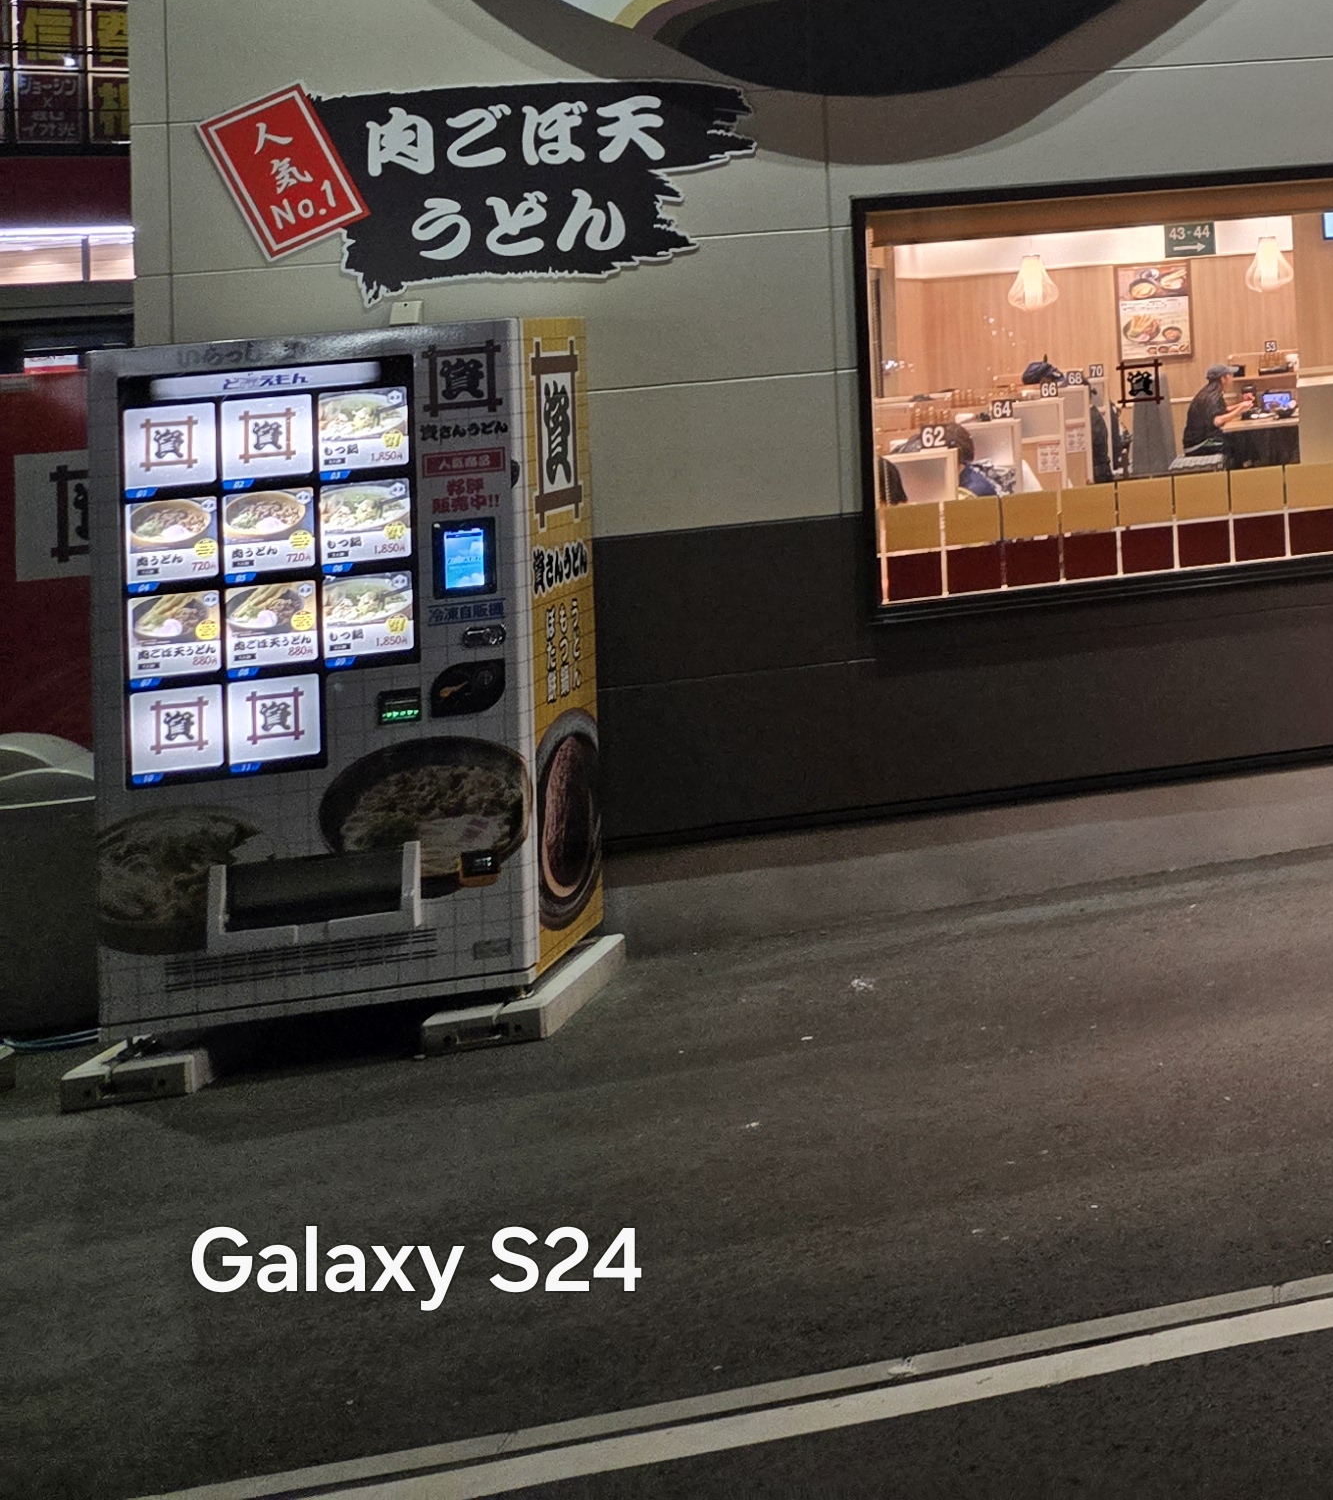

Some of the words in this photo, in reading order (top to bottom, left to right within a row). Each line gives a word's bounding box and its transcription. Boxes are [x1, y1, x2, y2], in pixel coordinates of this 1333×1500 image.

[366, 95, 665, 177] 肉ごぼ天
[255, 124, 313, 195] 人気
[270, 179, 338, 230] No.1
[411, 189, 626, 260] うどん
[440, 358, 483, 400] 資
[1041, 382, 1057, 397] 66
[1068, 372, 1082, 385] 68
[1091, 366, 1102, 377] 70
[420, 421, 508, 441] 資さんうどん
[993, 403, 1011, 418] 64
[544, 380, 571, 485] 資
[922, 426, 946, 447] 62
[534, 542, 587, 594] 資さんうどん
